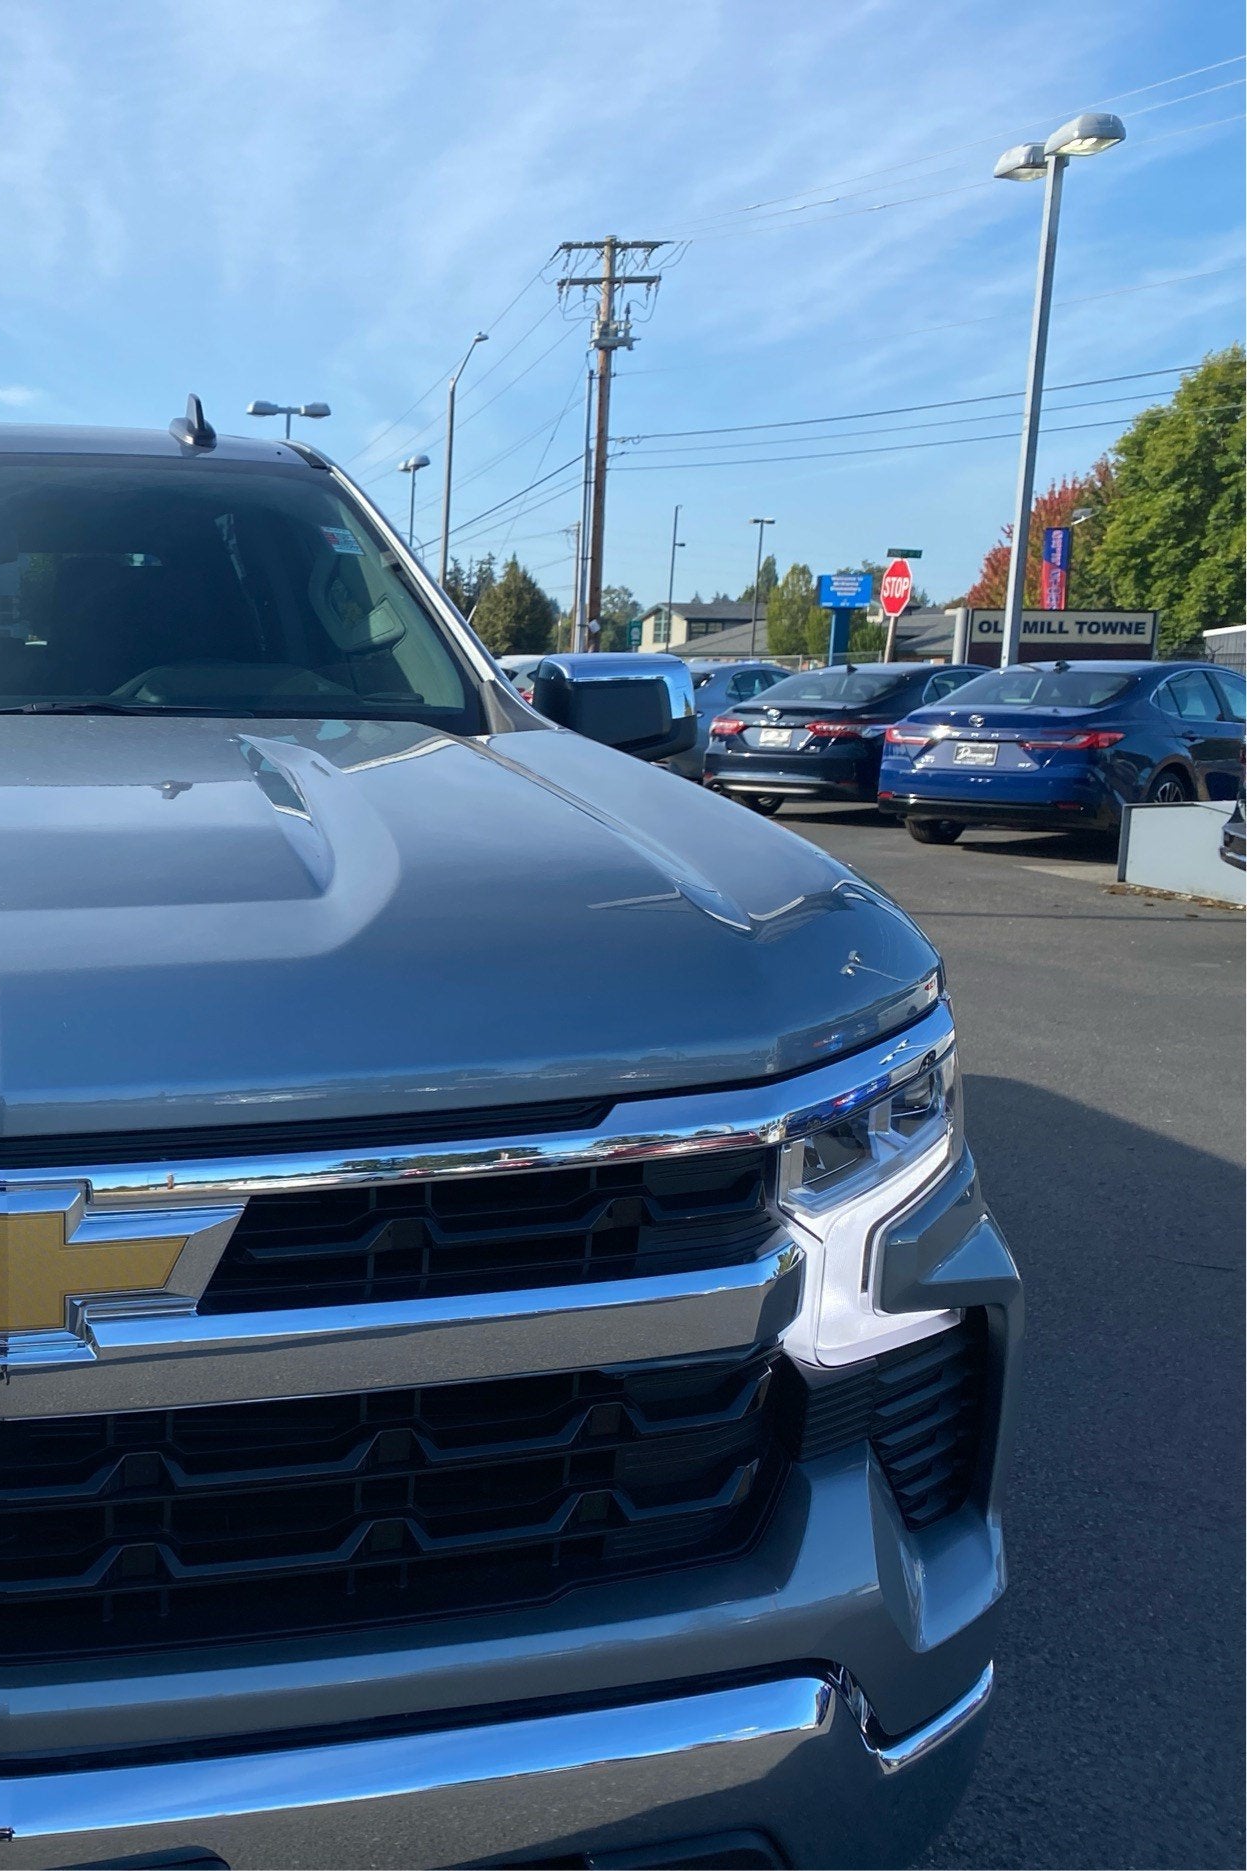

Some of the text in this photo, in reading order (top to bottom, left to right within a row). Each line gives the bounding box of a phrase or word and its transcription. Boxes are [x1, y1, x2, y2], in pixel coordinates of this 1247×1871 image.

[883, 576, 910, 599] STOP
[978, 620, 1146, 635] OL MILL TOWNE
